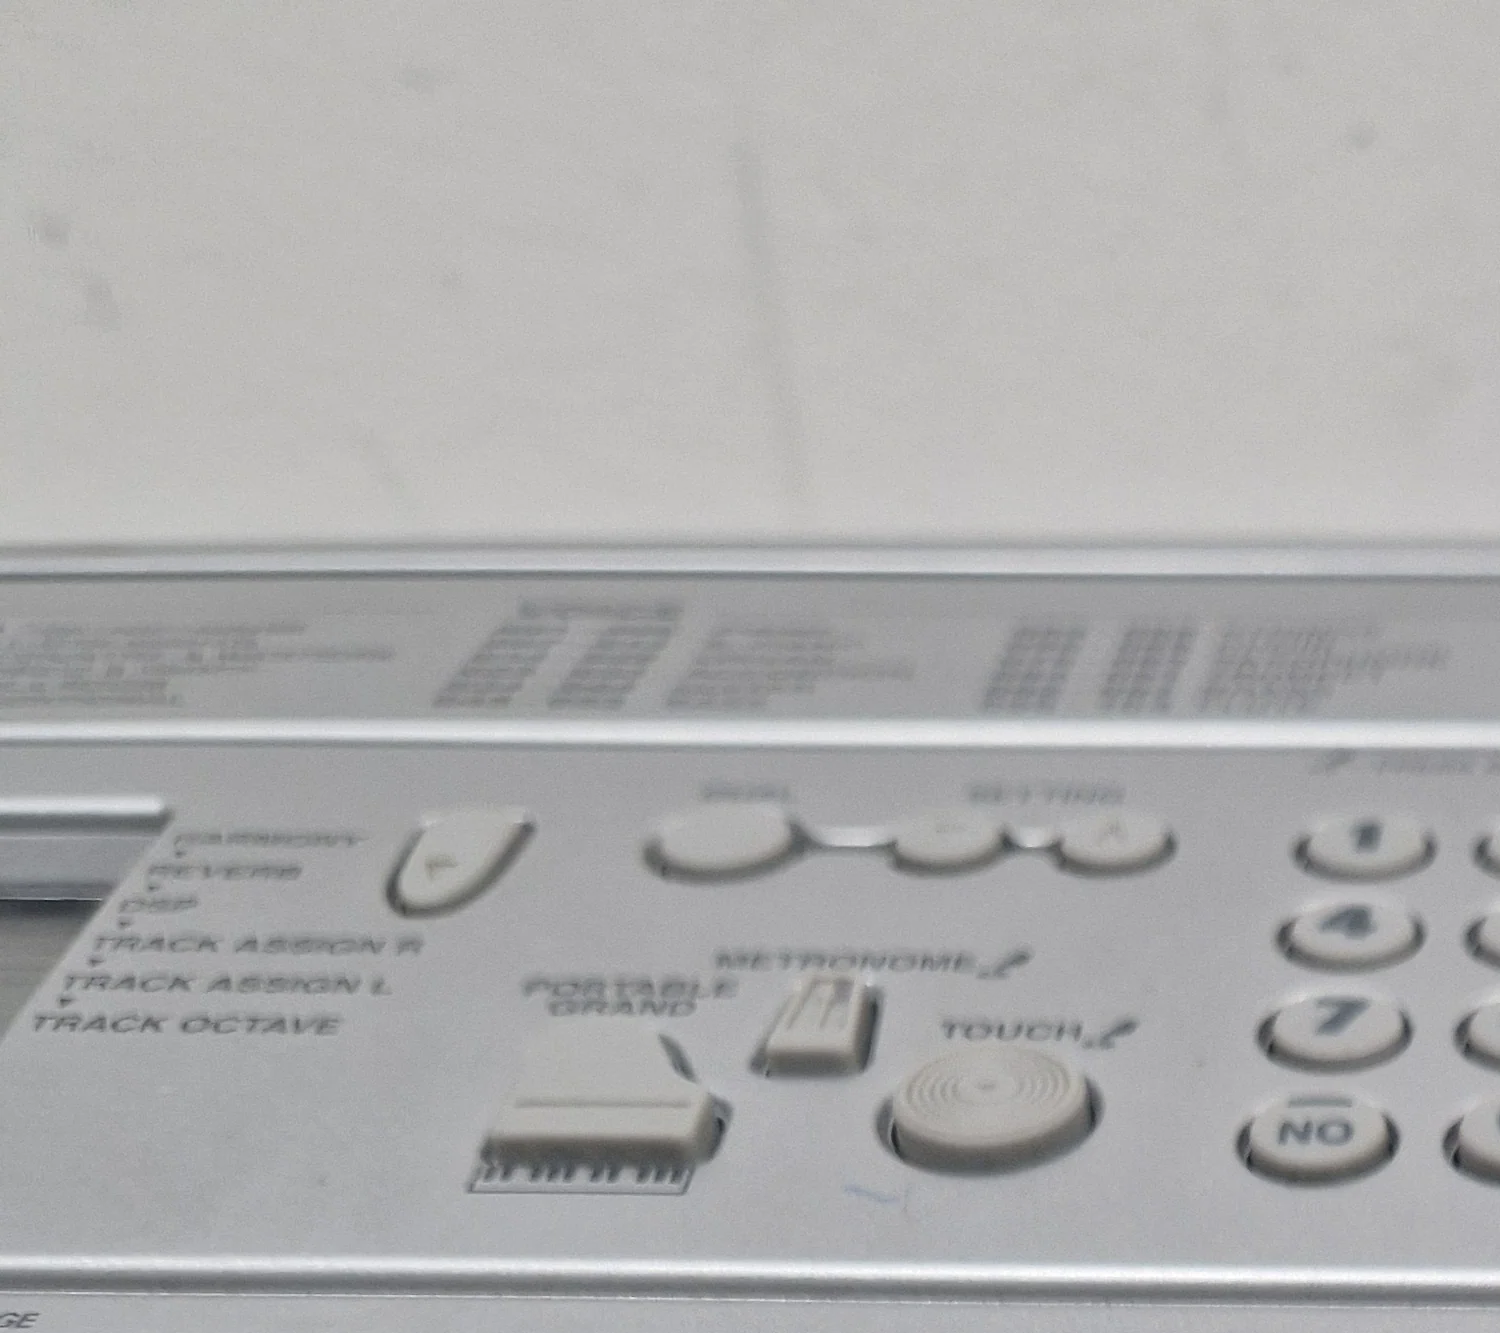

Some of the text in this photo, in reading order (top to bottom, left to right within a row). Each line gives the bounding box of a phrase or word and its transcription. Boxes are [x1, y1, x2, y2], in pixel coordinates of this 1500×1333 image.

[1351, 818, 1382, 854] 1
[1318, 903, 1376, 939] 4
[97, 933, 222, 954] TRACK
[234, 934, 388, 955] ASSIGN
[713, 948, 977, 974] METRONOME
[64, 974, 393, 996] TRACK ASSIGN L
[520, 975, 741, 1000] PORTABLE
[33, 1012, 345, 1036] TRACK OCTAVE
[1313, 995, 1373, 1036] 7
[940, 1017, 1086, 1042] TOUCH
[1277, 1119, 1355, 1147] NO
